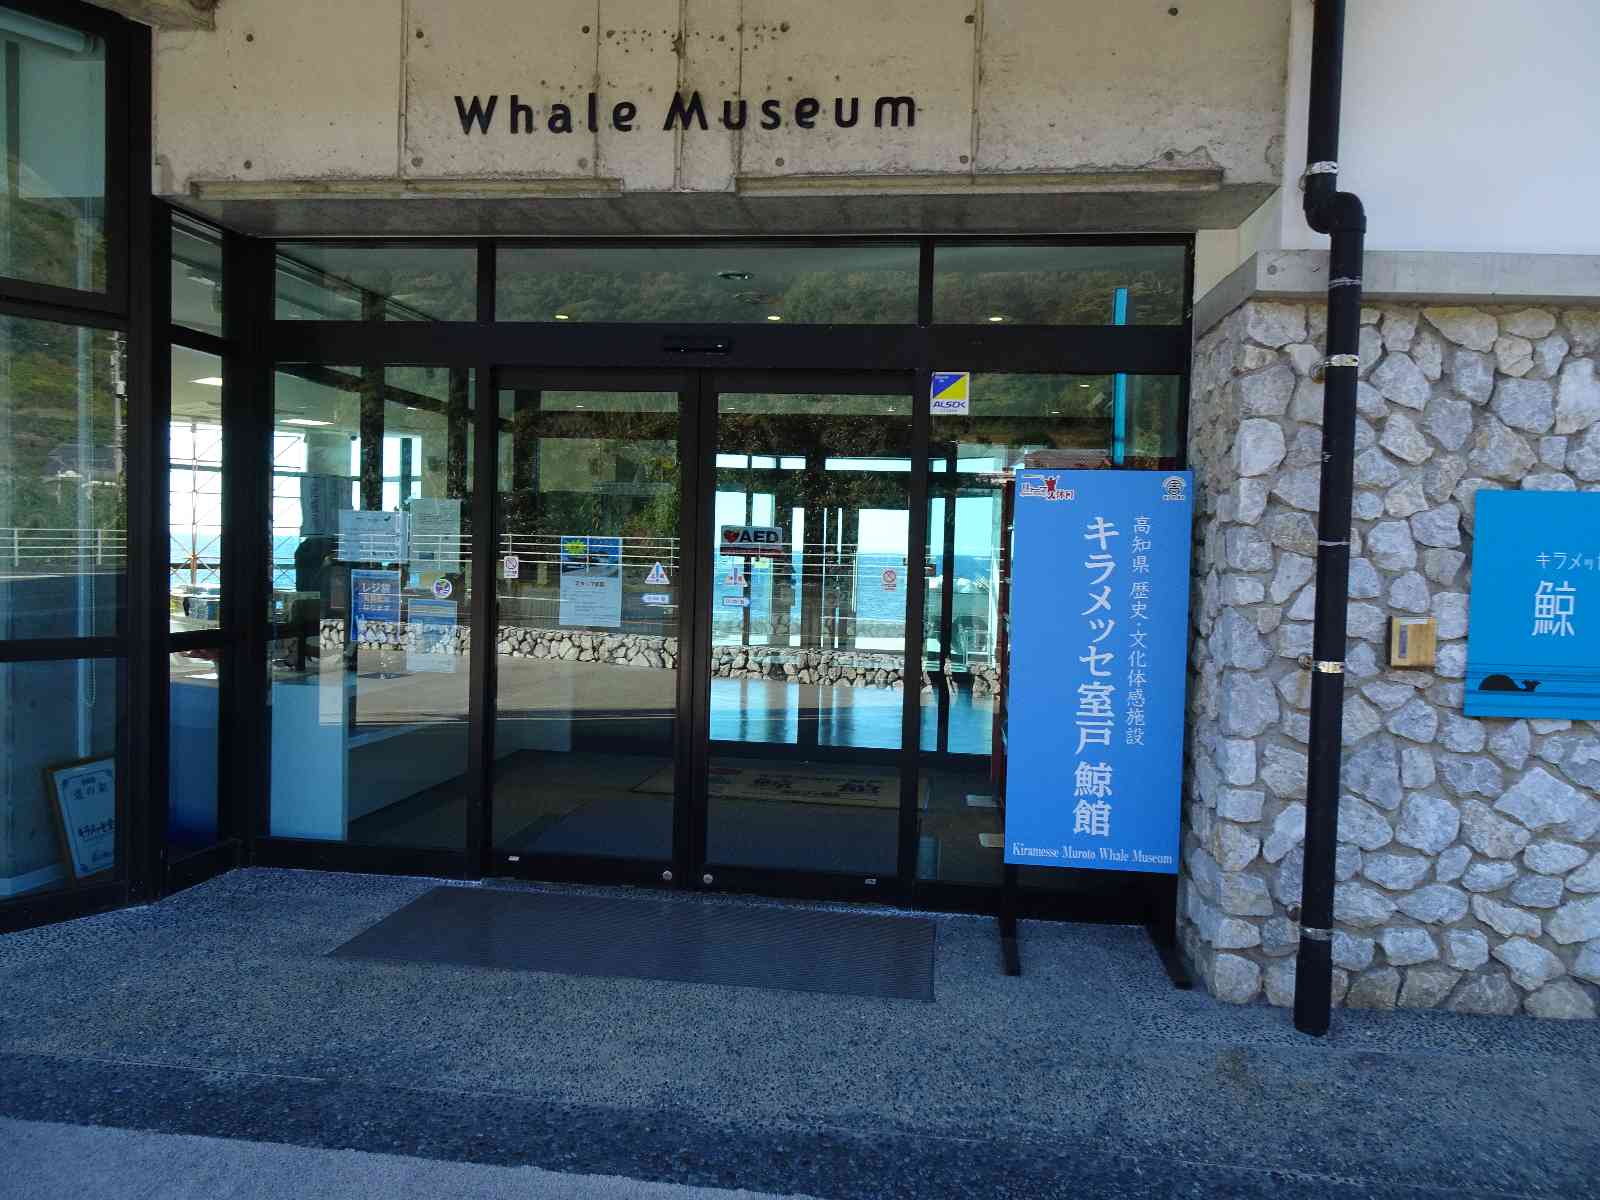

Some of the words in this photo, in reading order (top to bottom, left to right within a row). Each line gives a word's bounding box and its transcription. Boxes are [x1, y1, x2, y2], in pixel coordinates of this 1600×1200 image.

[454, 92, 637, 135] Whale
[662, 90, 916, 132] Museum
[739, 530, 779, 543] AED
[1535, 551, 1600, 571] キラメッ
[1531, 579, 1577, 637] 鯨
[1012, 842, 1059, 858] Kiramesse
[1061, 845, 1096, 860] Muroto
[1099, 847, 1130, 863] Whale
[1132, 849, 1173, 865] Museum
